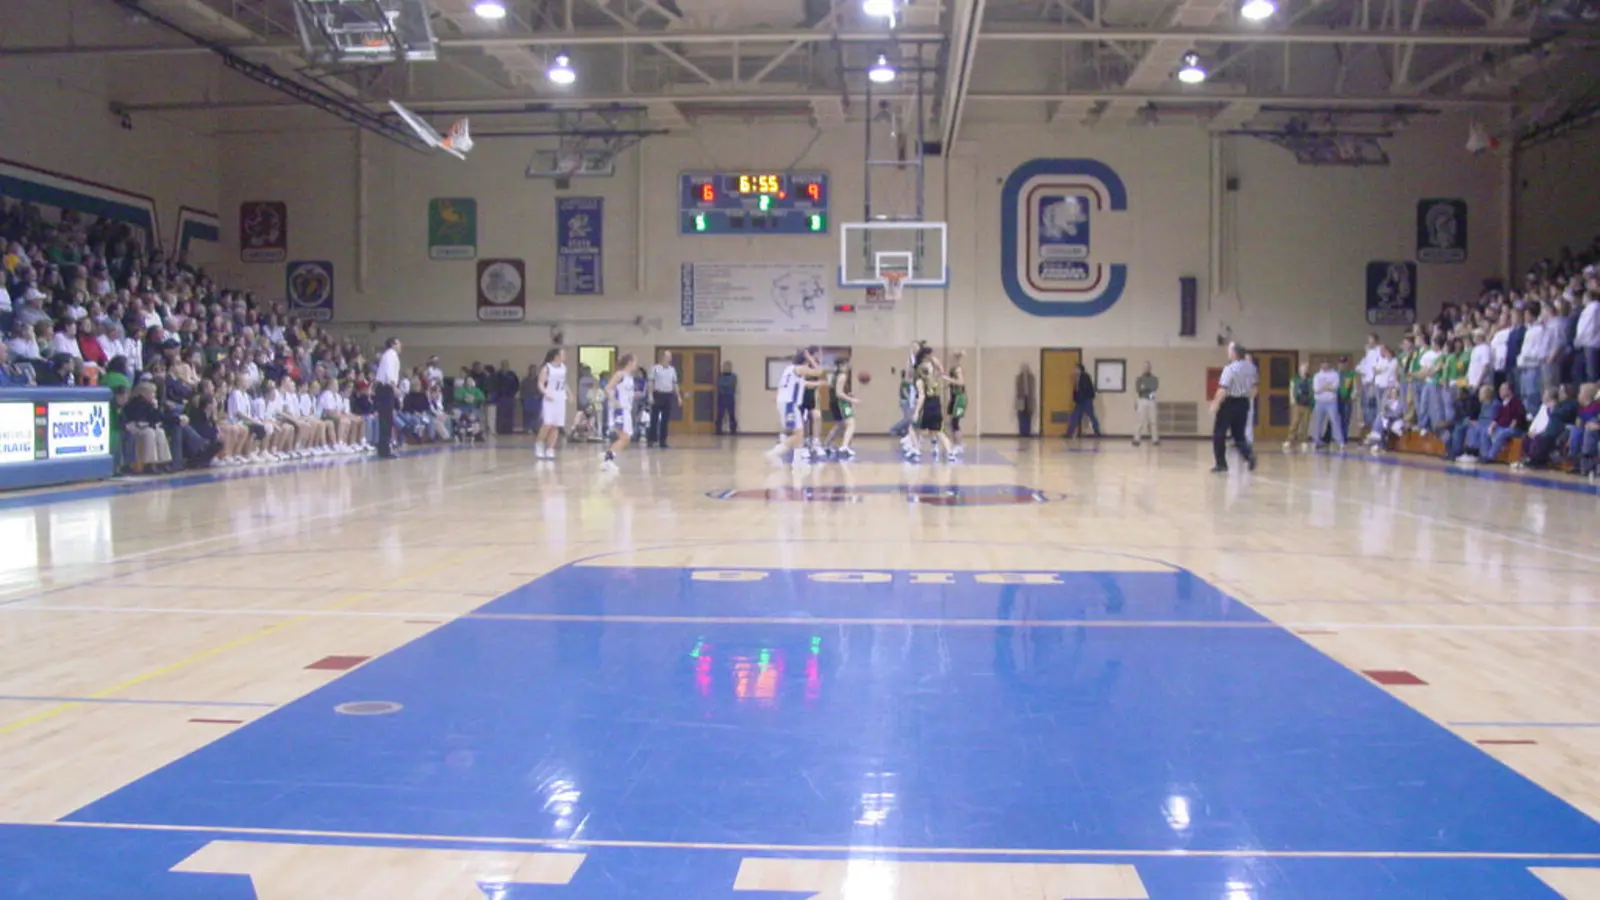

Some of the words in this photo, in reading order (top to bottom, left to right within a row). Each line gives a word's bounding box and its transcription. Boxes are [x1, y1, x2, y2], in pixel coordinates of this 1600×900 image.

[703, 184, 714, 201] 6
[739, 175, 779, 193] 6:55
[808, 184, 820, 200] 9
[53, 421, 89, 439] COUGARS
